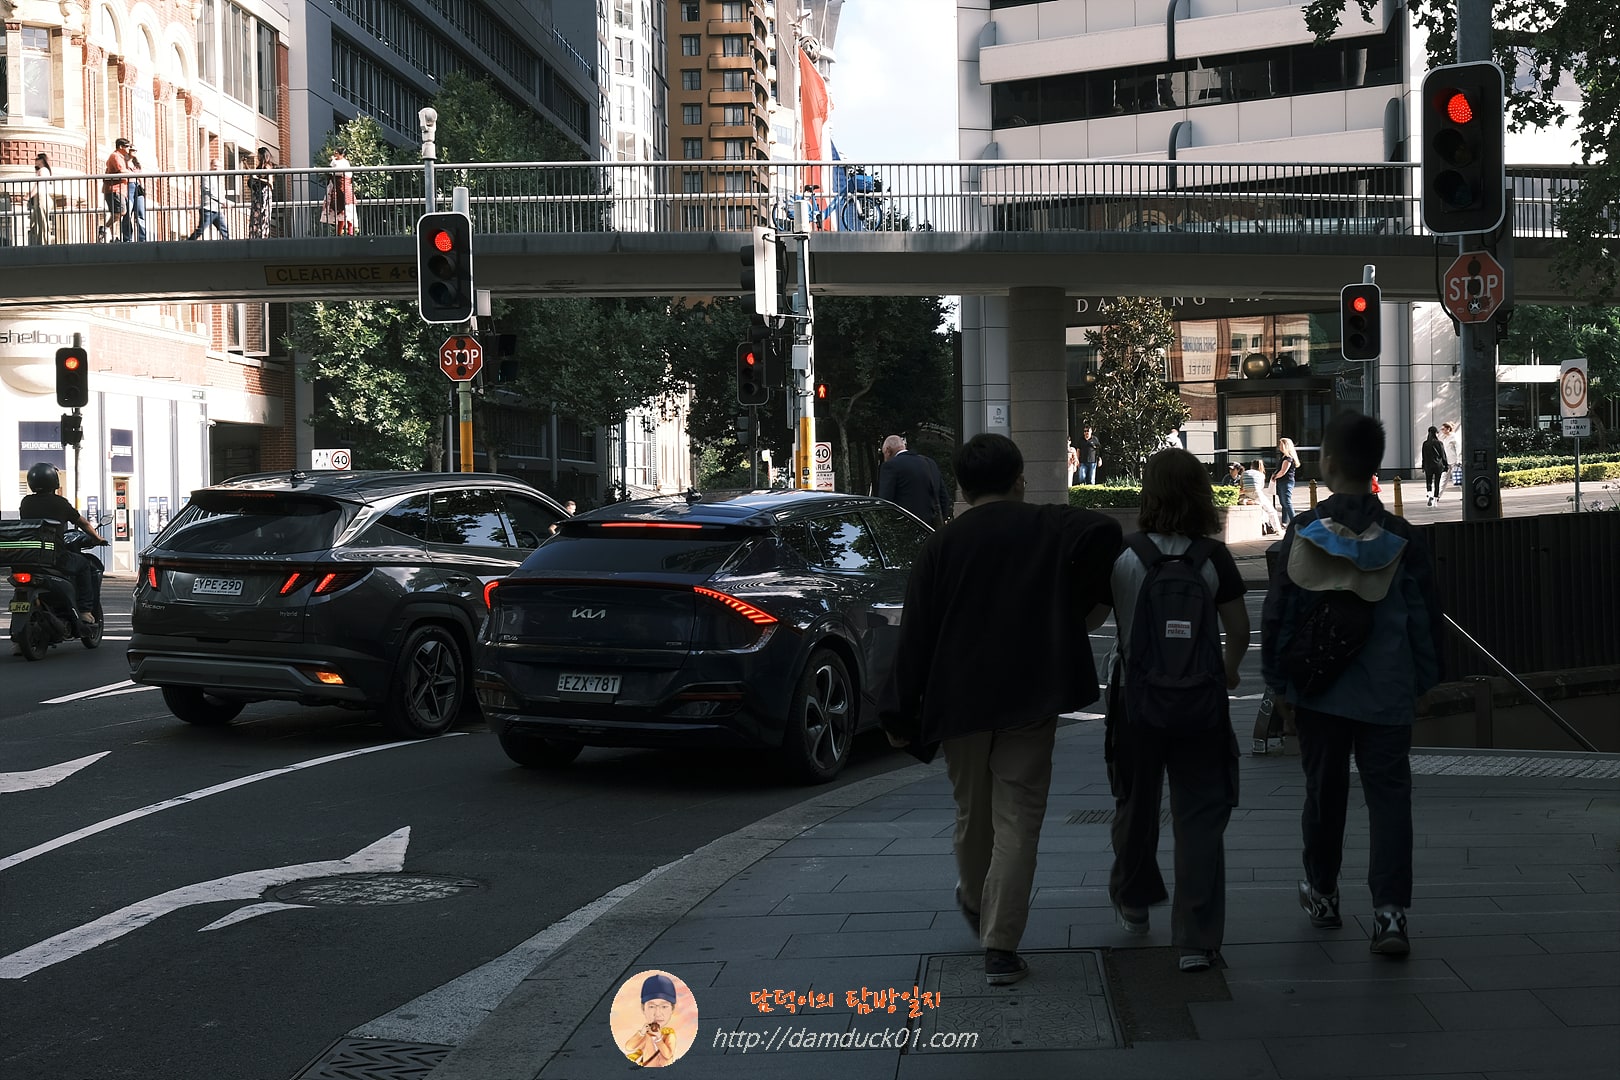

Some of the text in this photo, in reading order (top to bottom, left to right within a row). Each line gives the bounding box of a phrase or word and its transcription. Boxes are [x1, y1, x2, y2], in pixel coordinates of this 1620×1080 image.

[276, 266, 381, 281] CLEARANCE
[1449, 277, 1498, 300] STOP
[0, 329, 86, 347] shelboure
[444, 350, 479, 366] STOP
[1564, 379, 1582, 397] 60
[334, 454, 348, 465] 40
[815, 448, 829, 460] 40
[815, 463, 832, 471] REA
[571, 608, 607, 619] KIA
